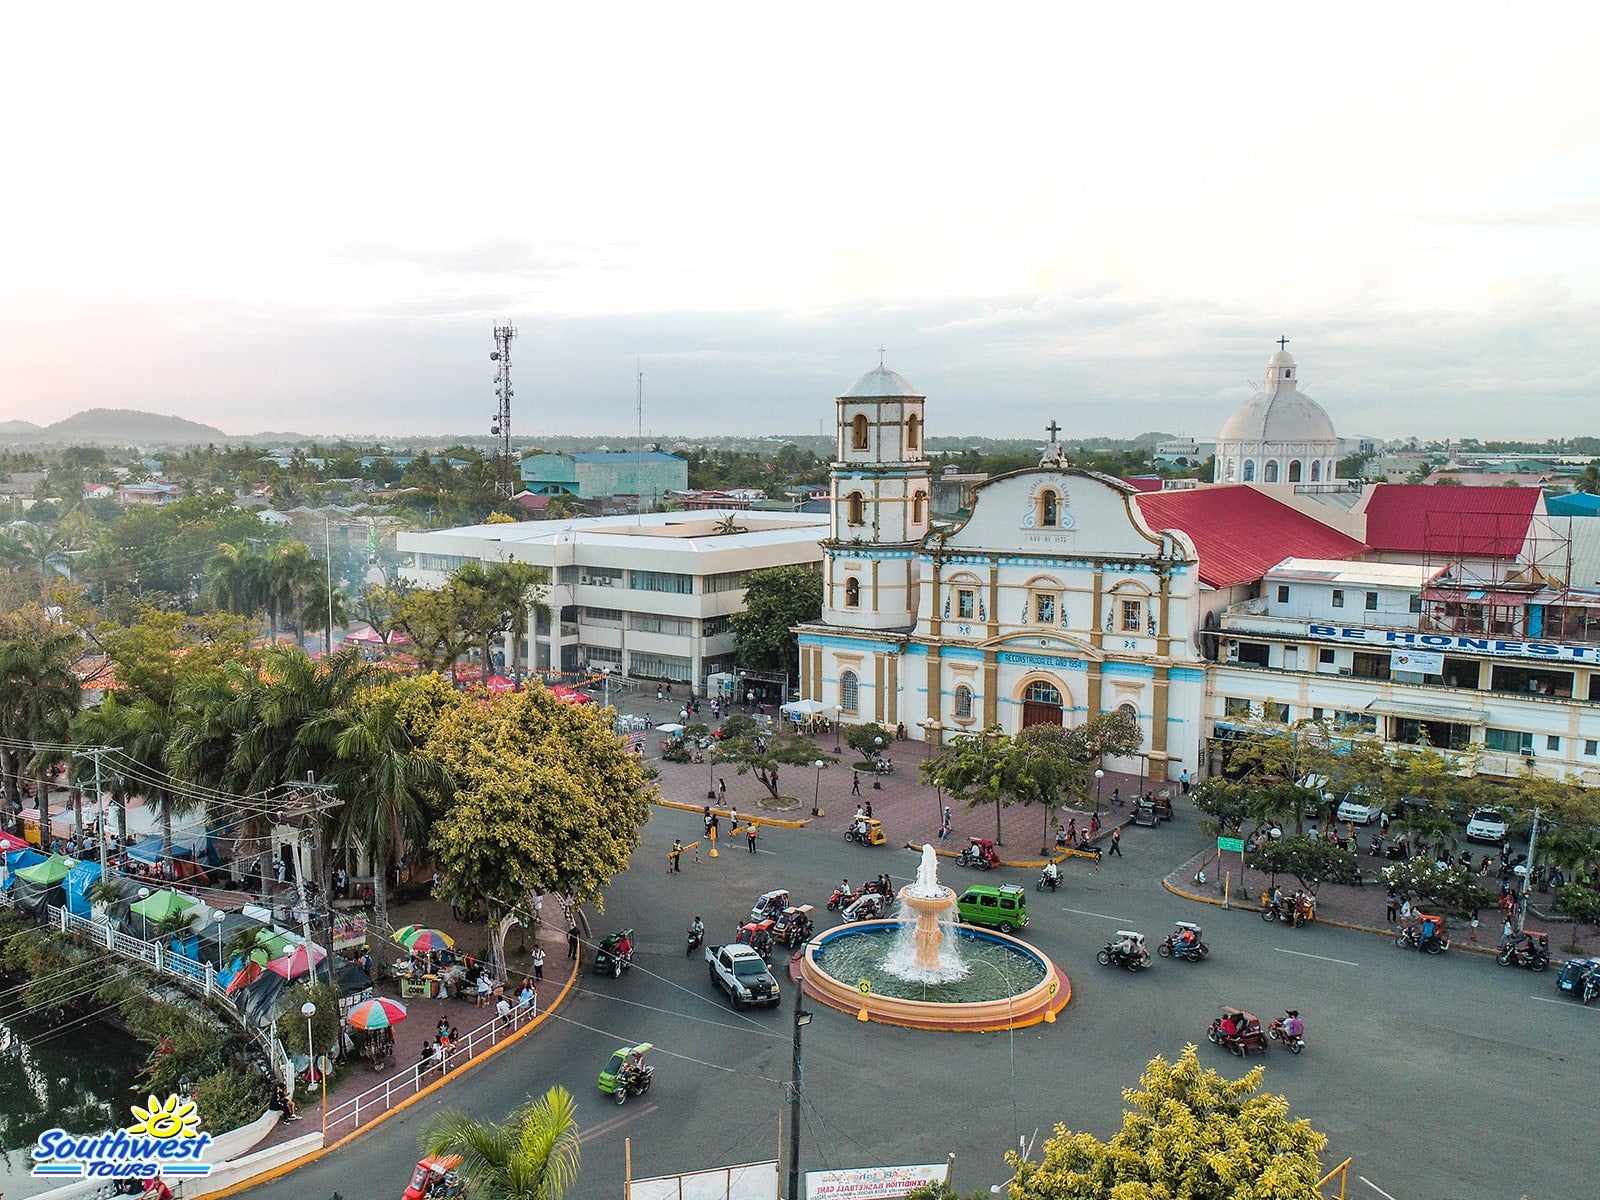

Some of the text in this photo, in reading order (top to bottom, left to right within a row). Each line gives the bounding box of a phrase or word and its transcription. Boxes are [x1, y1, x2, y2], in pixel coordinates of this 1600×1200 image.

[1309, 625, 1366, 639] BE
[1386, 632, 1593, 658] HONEST
[1046, 657, 1054, 666] EL
